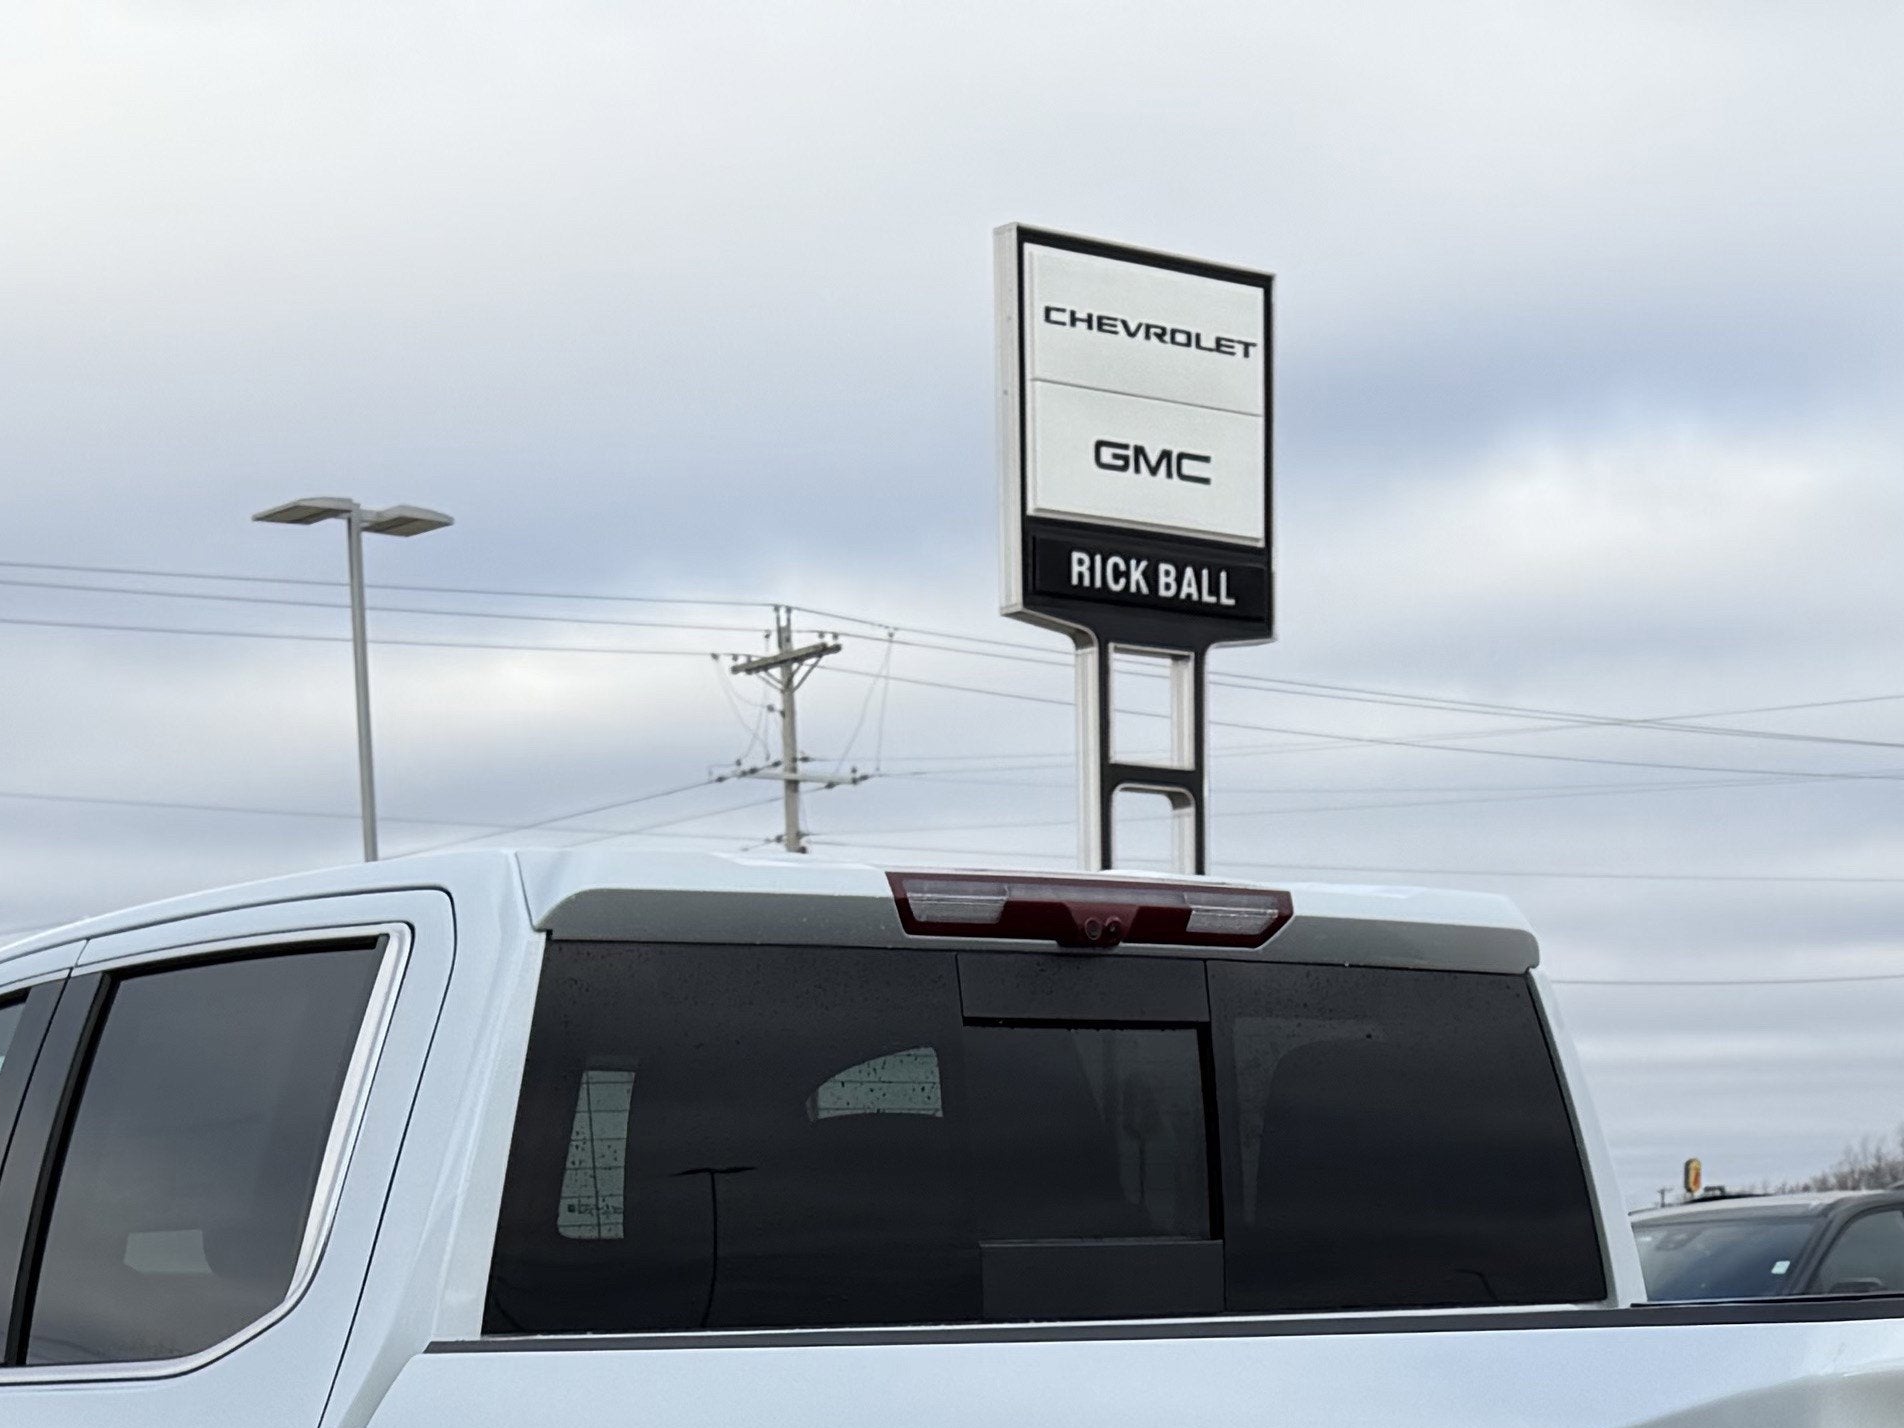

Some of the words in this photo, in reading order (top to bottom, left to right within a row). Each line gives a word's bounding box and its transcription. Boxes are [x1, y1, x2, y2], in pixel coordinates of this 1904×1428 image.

[1043, 304, 1257, 359] CHEVROLET
[1094, 439, 1212, 486] GMC
[1070, 550, 1149, 596] RICK
[1158, 562, 1236, 606] BALL
